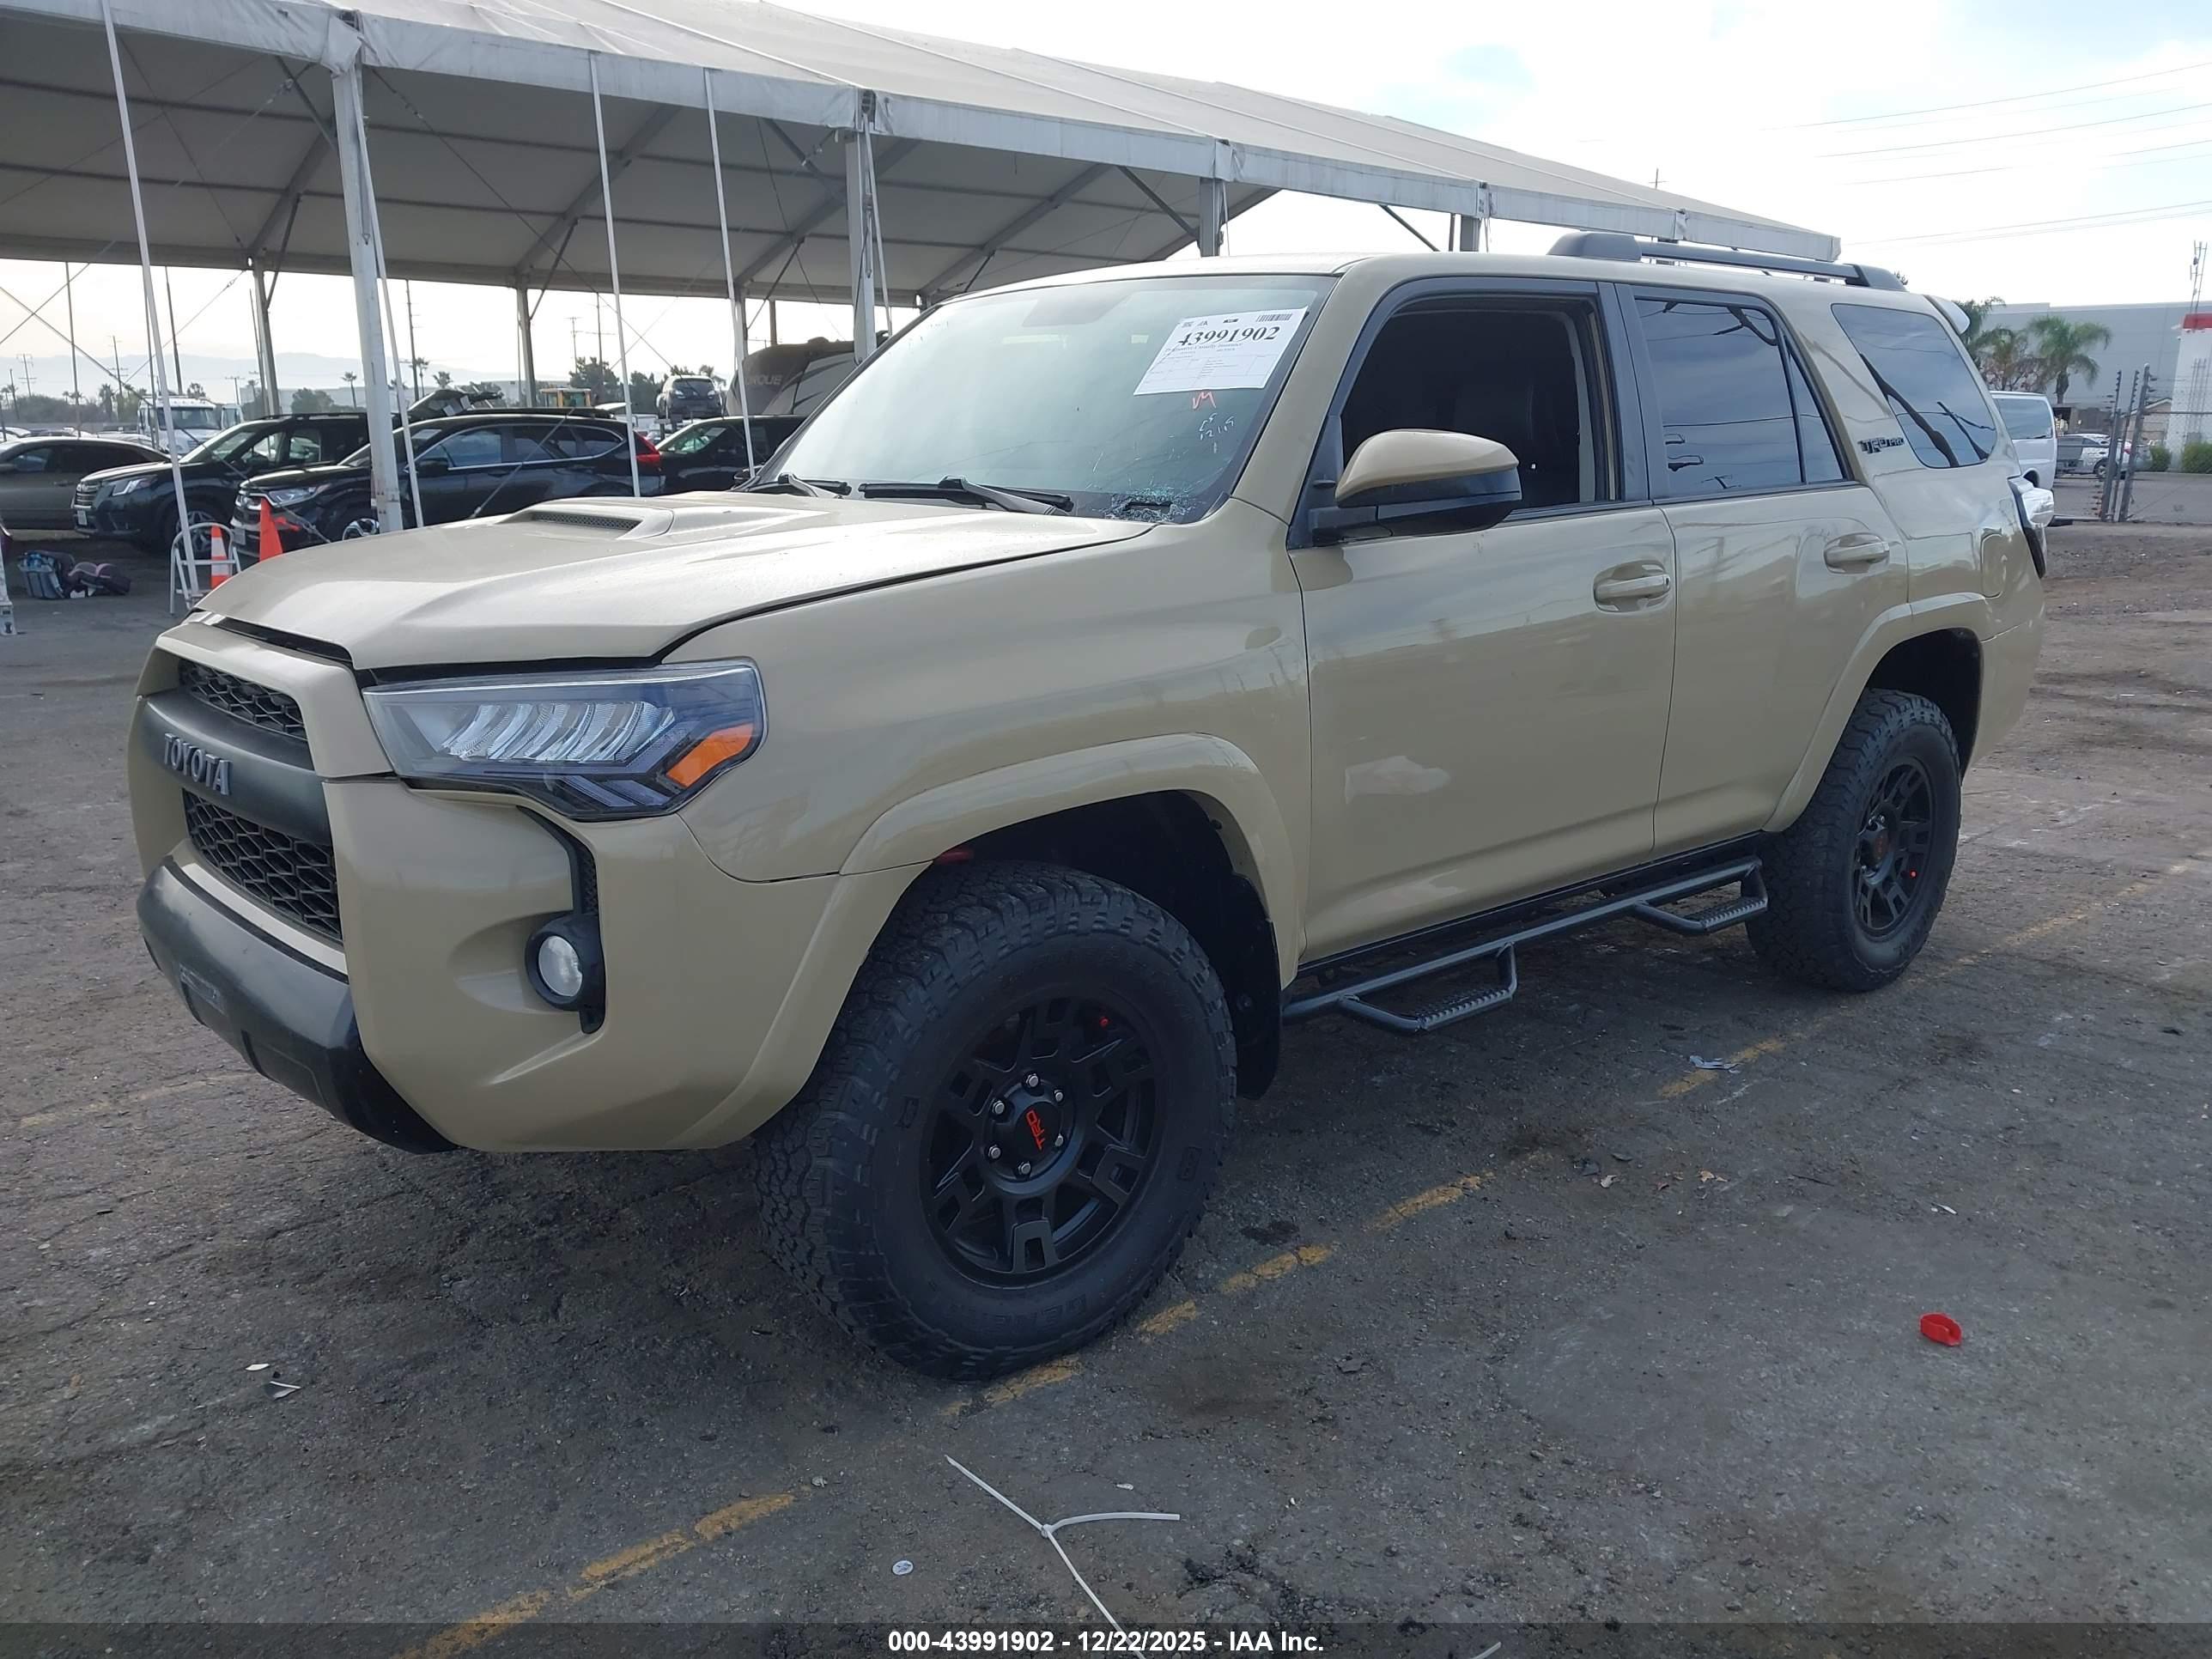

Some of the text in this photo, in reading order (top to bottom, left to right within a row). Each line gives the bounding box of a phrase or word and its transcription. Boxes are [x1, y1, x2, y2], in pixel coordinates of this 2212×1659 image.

[1178, 325, 1280, 346] 43991902
[164, 732, 233, 795] TOYOTA
[1025, 1109, 1046, 1151] TRD
